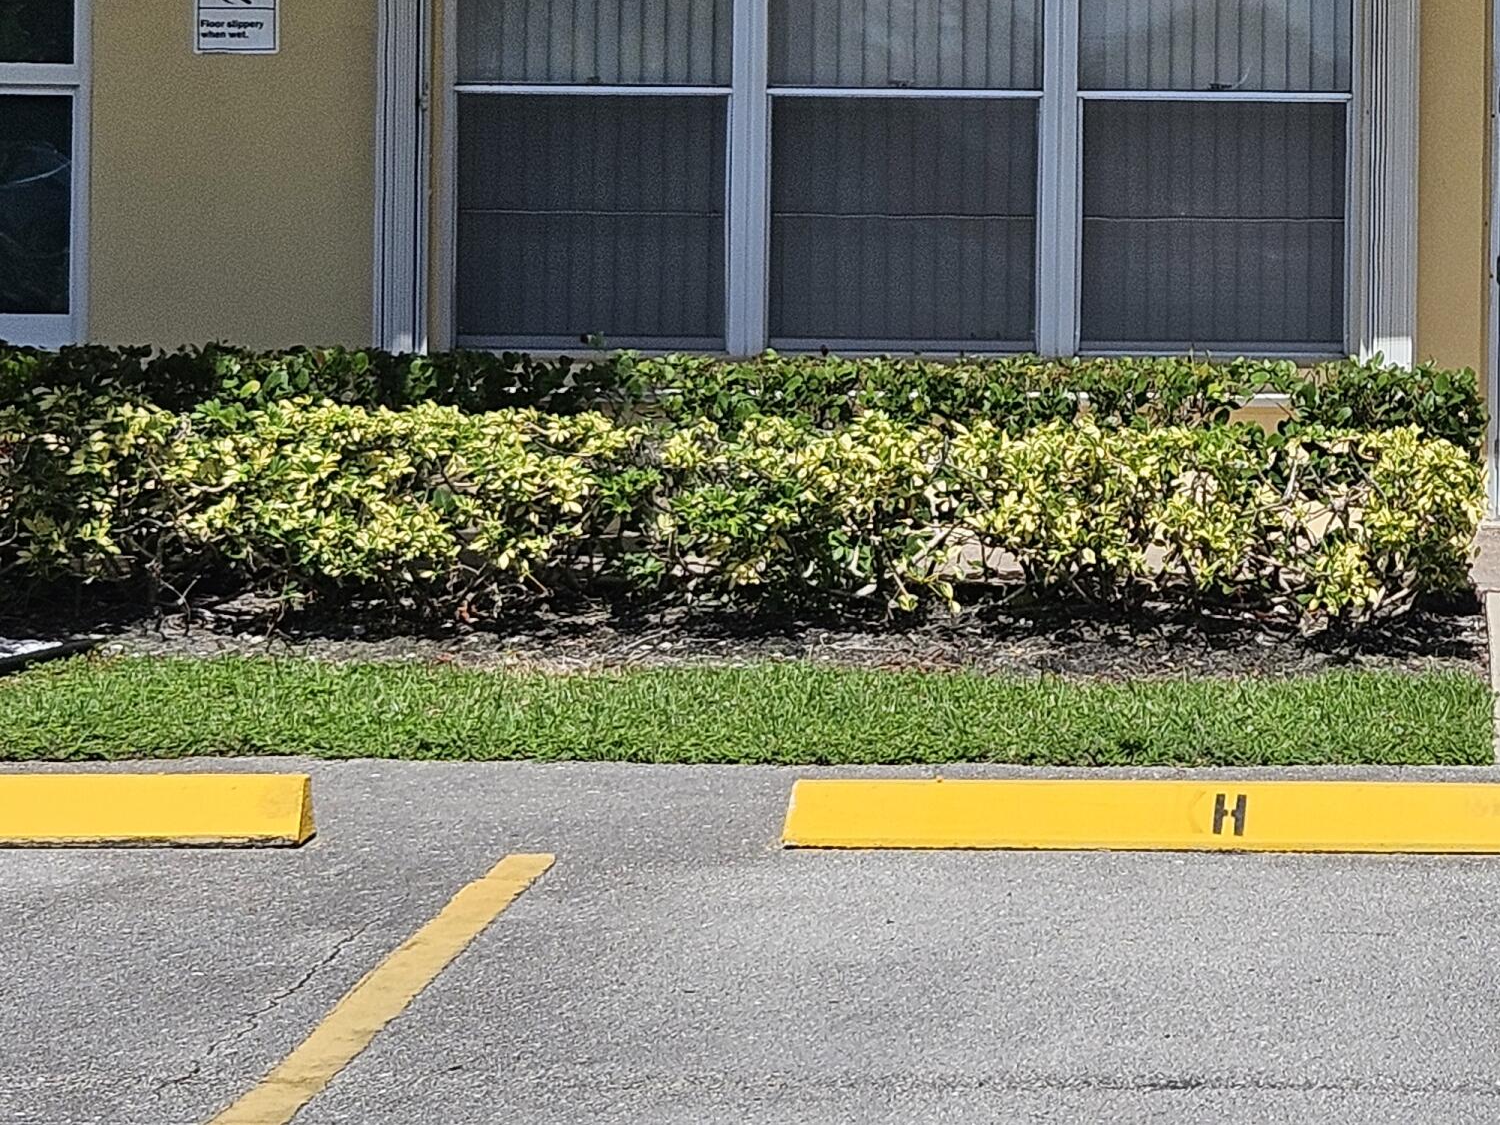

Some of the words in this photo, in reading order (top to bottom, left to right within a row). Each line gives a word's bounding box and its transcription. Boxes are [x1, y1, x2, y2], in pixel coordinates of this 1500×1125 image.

[200, 19, 225, 28] Floor
[226, 20, 264, 30] slippery
[200, 30, 226, 38] when
[228, 30, 250, 39] wet.
[1213, 793, 1247, 837] H
